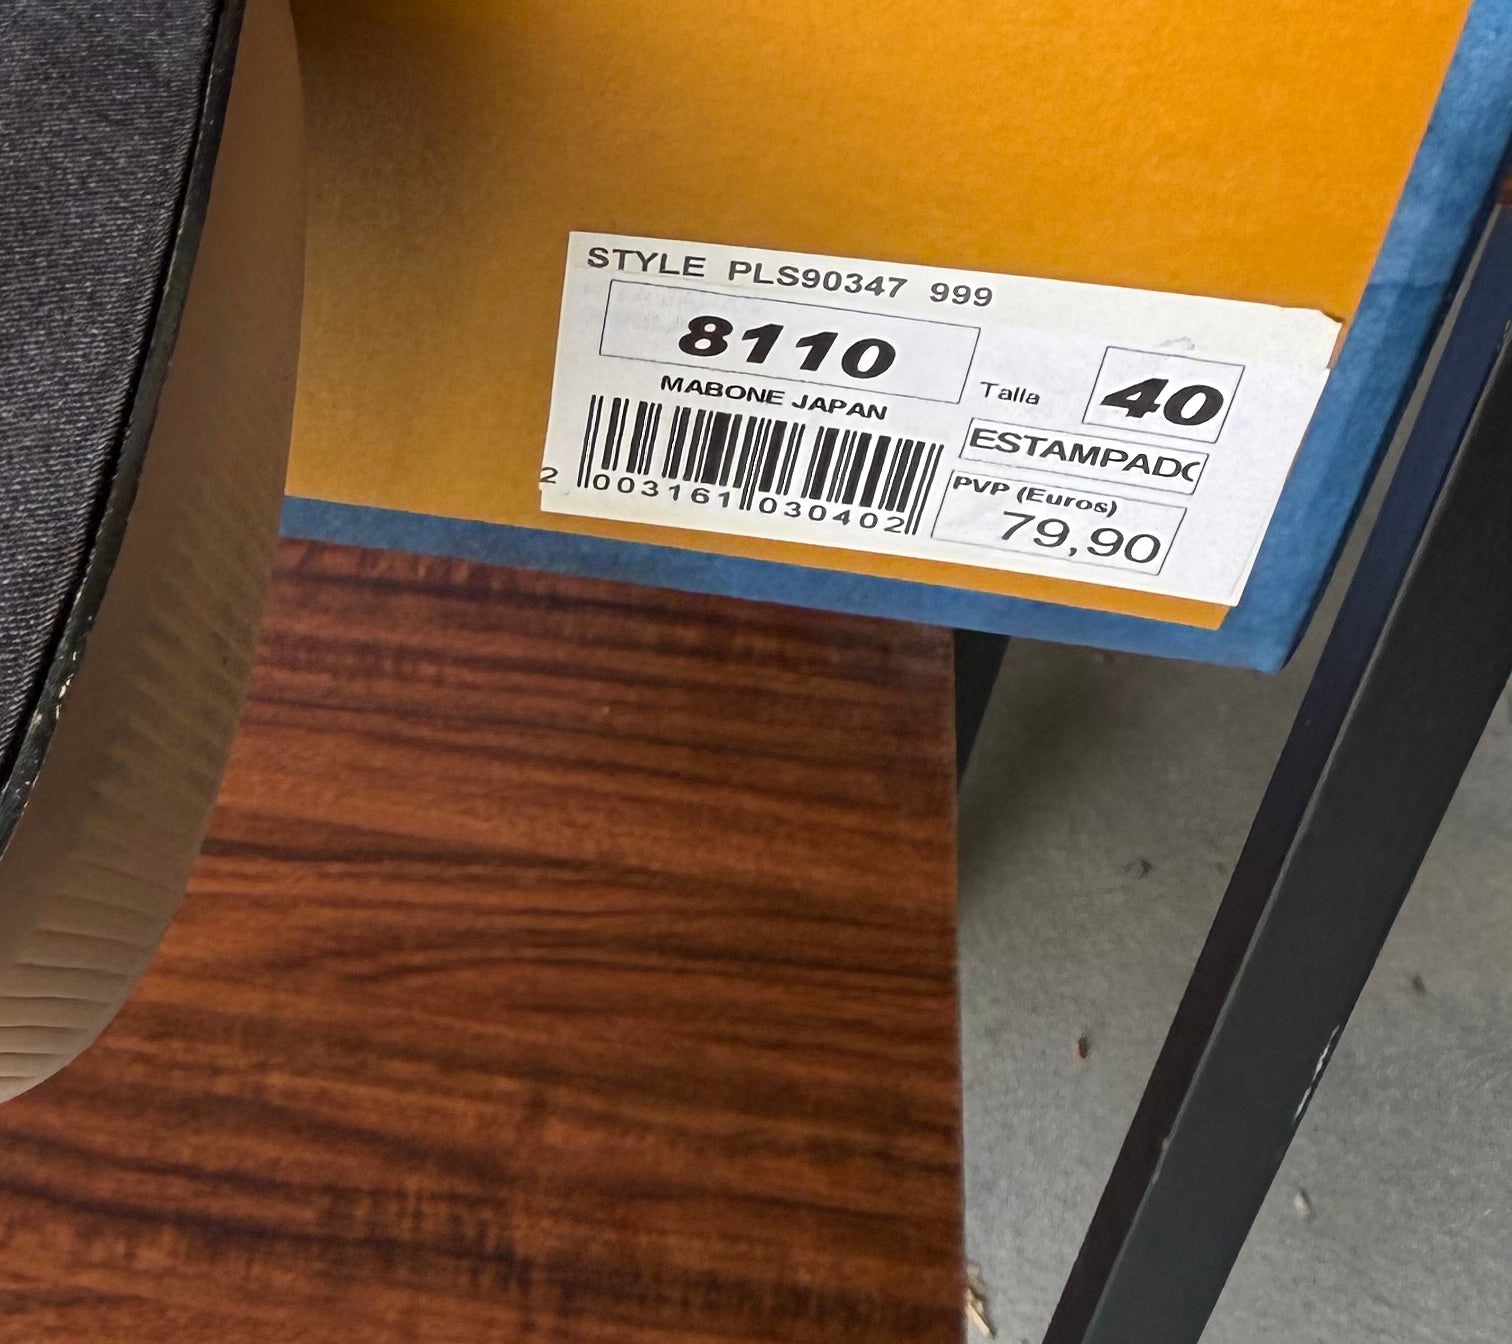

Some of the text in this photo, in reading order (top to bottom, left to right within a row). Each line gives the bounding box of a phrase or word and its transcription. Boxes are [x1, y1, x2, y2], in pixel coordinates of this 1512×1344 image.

[586, 246, 993, 308] STYLE PLS90347 999
[678, 315, 897, 380] 8110
[660, 375, 889, 421] MABONE JAPAN
[980, 377, 1225, 426] Talla 40
[952, 475, 1119, 518] PVP (Euros)
[1000, 510, 1162, 564] 79,90
